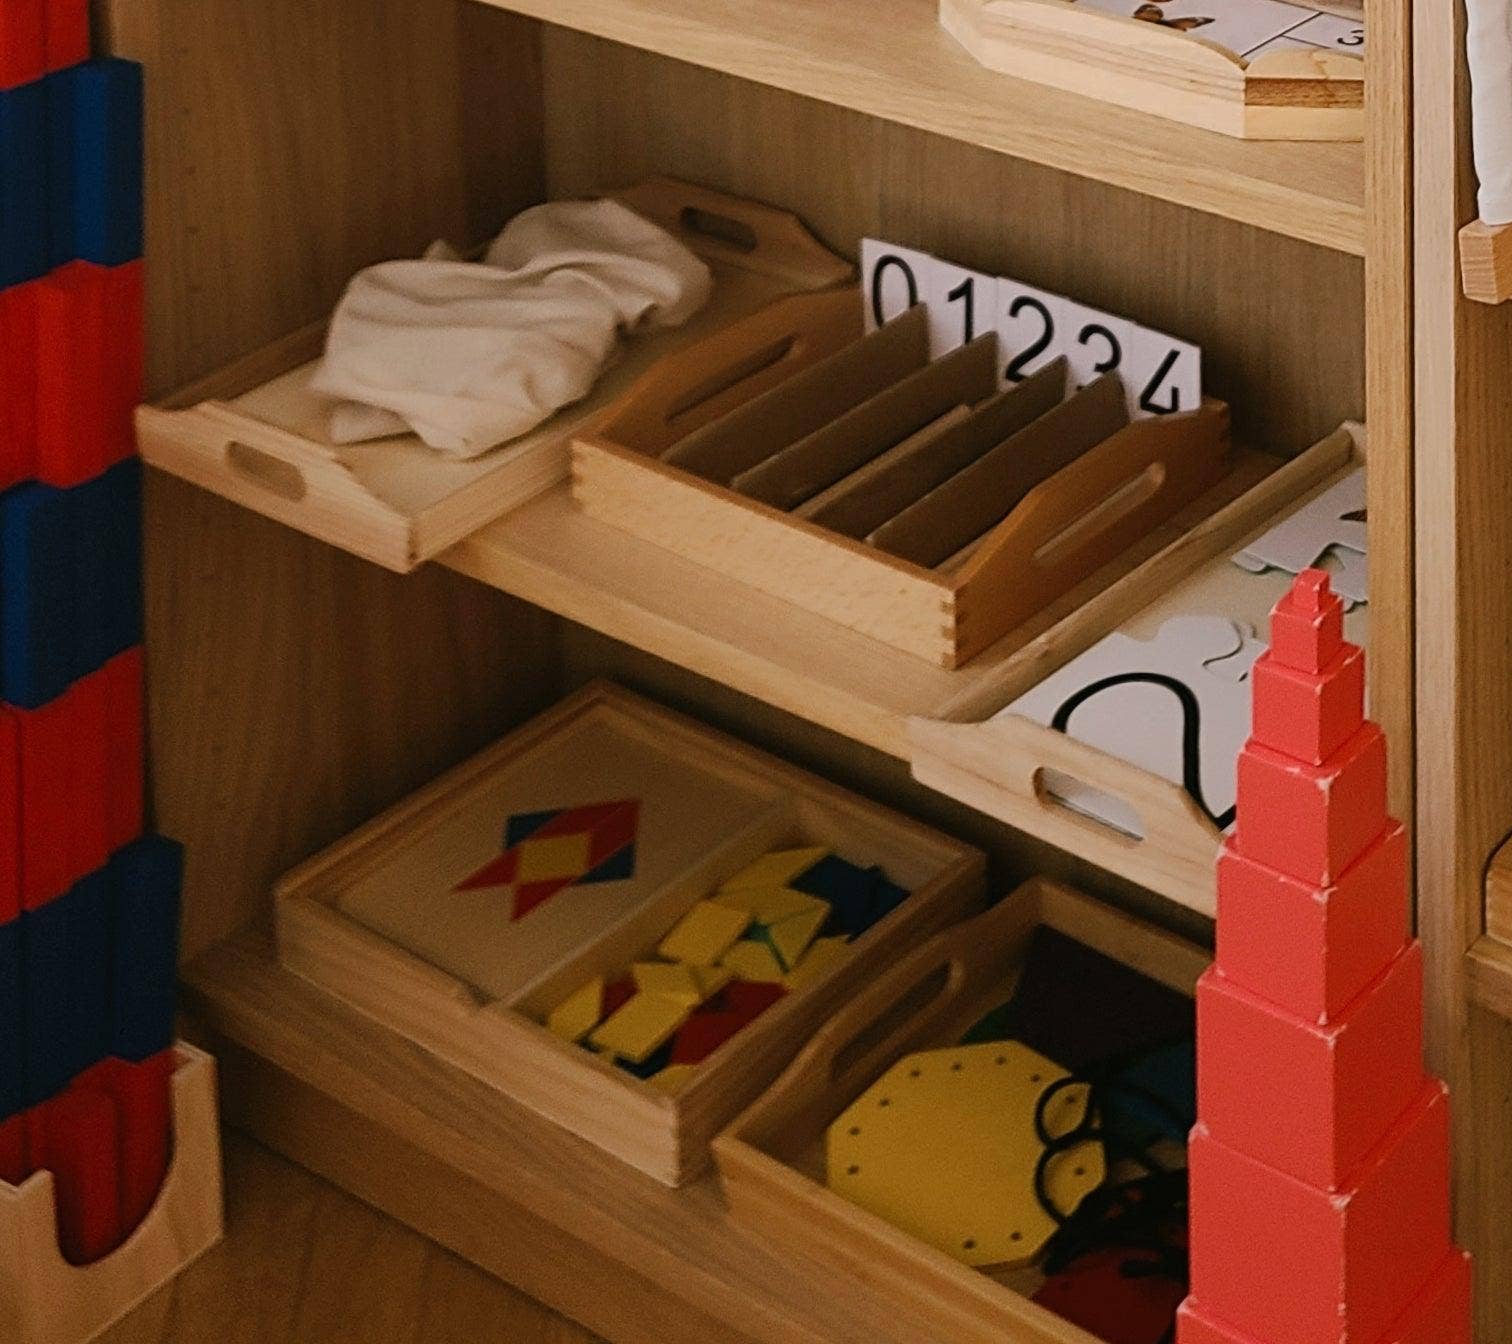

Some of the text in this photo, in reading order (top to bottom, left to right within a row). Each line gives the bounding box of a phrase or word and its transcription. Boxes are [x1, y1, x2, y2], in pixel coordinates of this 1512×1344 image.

[872, 255, 918, 329] 0
[948, 277, 975, 347] 1
[1005, 296, 1054, 384] 2
[1140, 349, 1180, 415] 4
